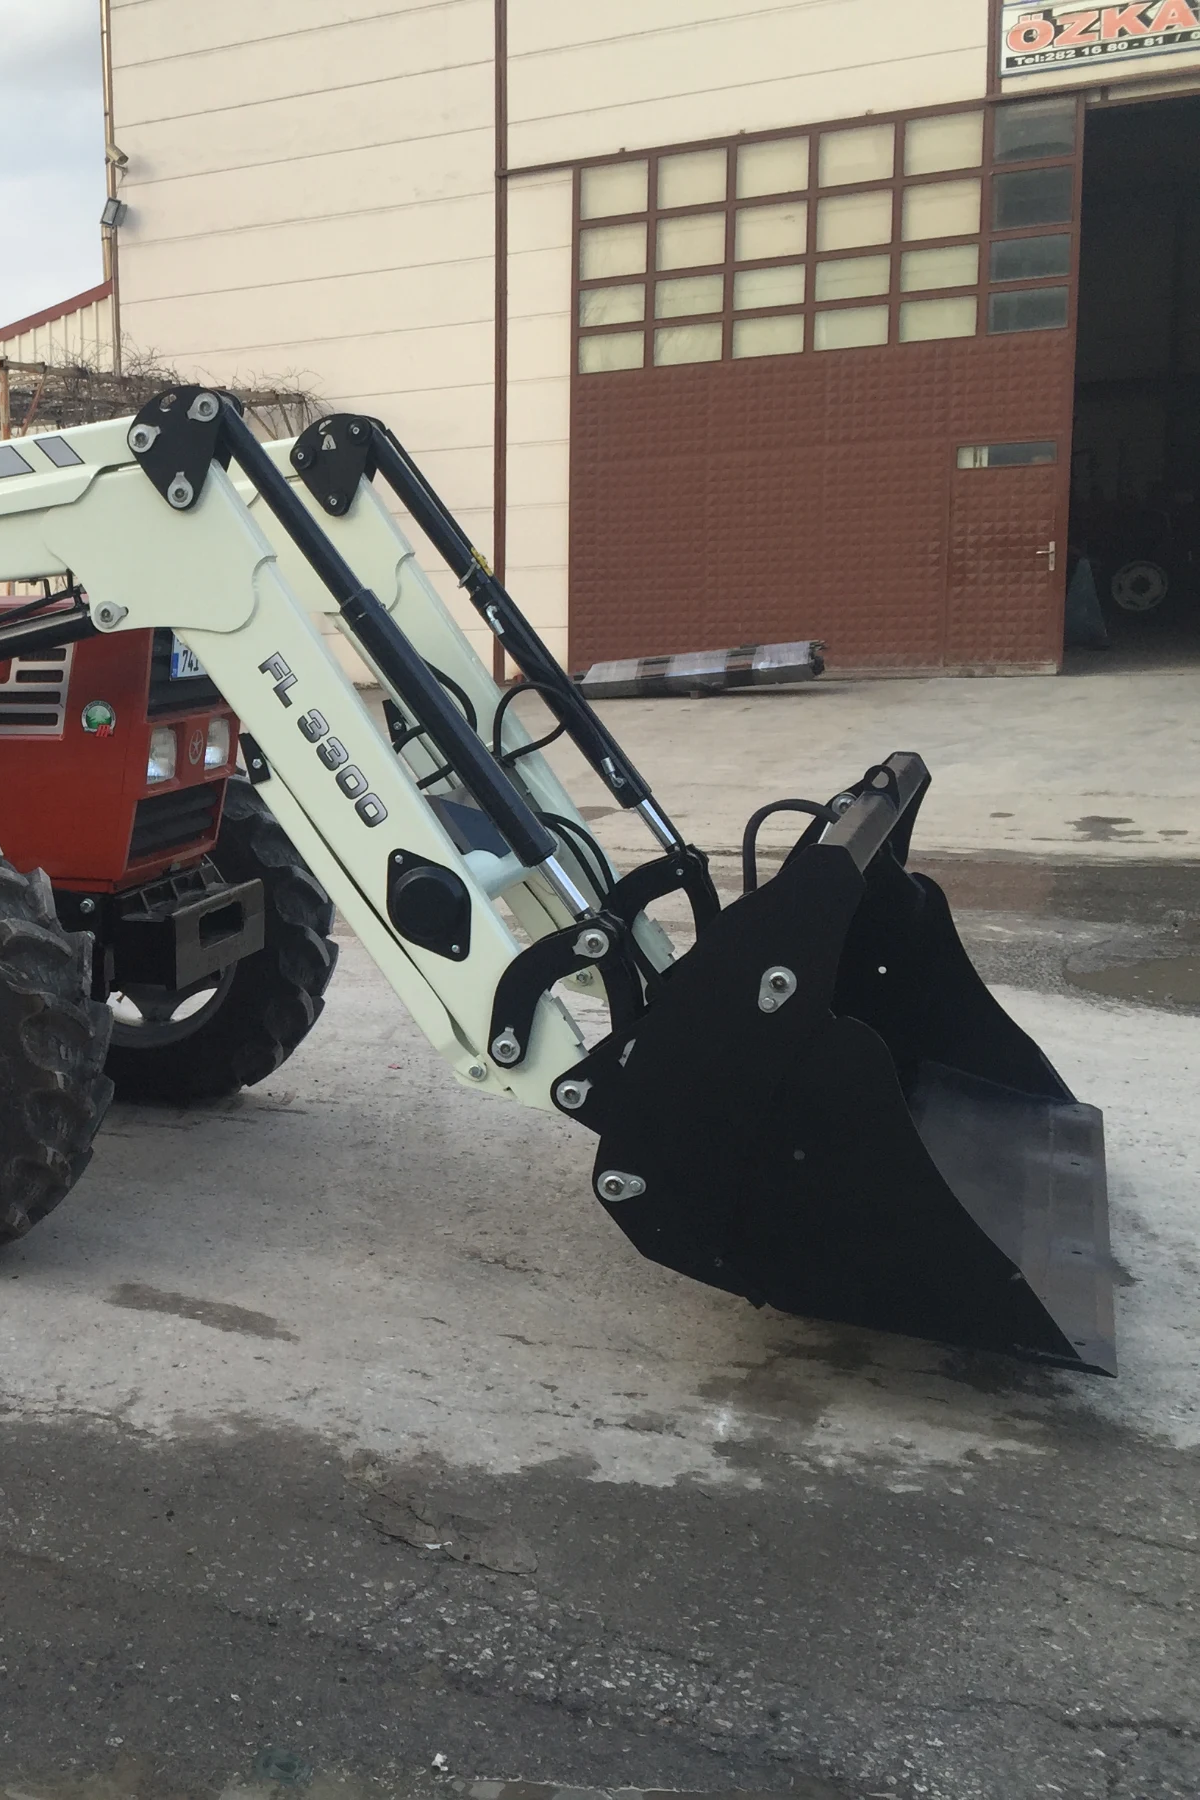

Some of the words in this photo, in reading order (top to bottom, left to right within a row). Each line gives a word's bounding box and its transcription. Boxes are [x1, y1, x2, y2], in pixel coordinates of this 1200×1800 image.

[1014, 49, 1076, 65] Tel:282
[1106, 41, 1129, 51] 80
[257, 651, 298, 709] FL
[296, 708, 388, 828] 3300
